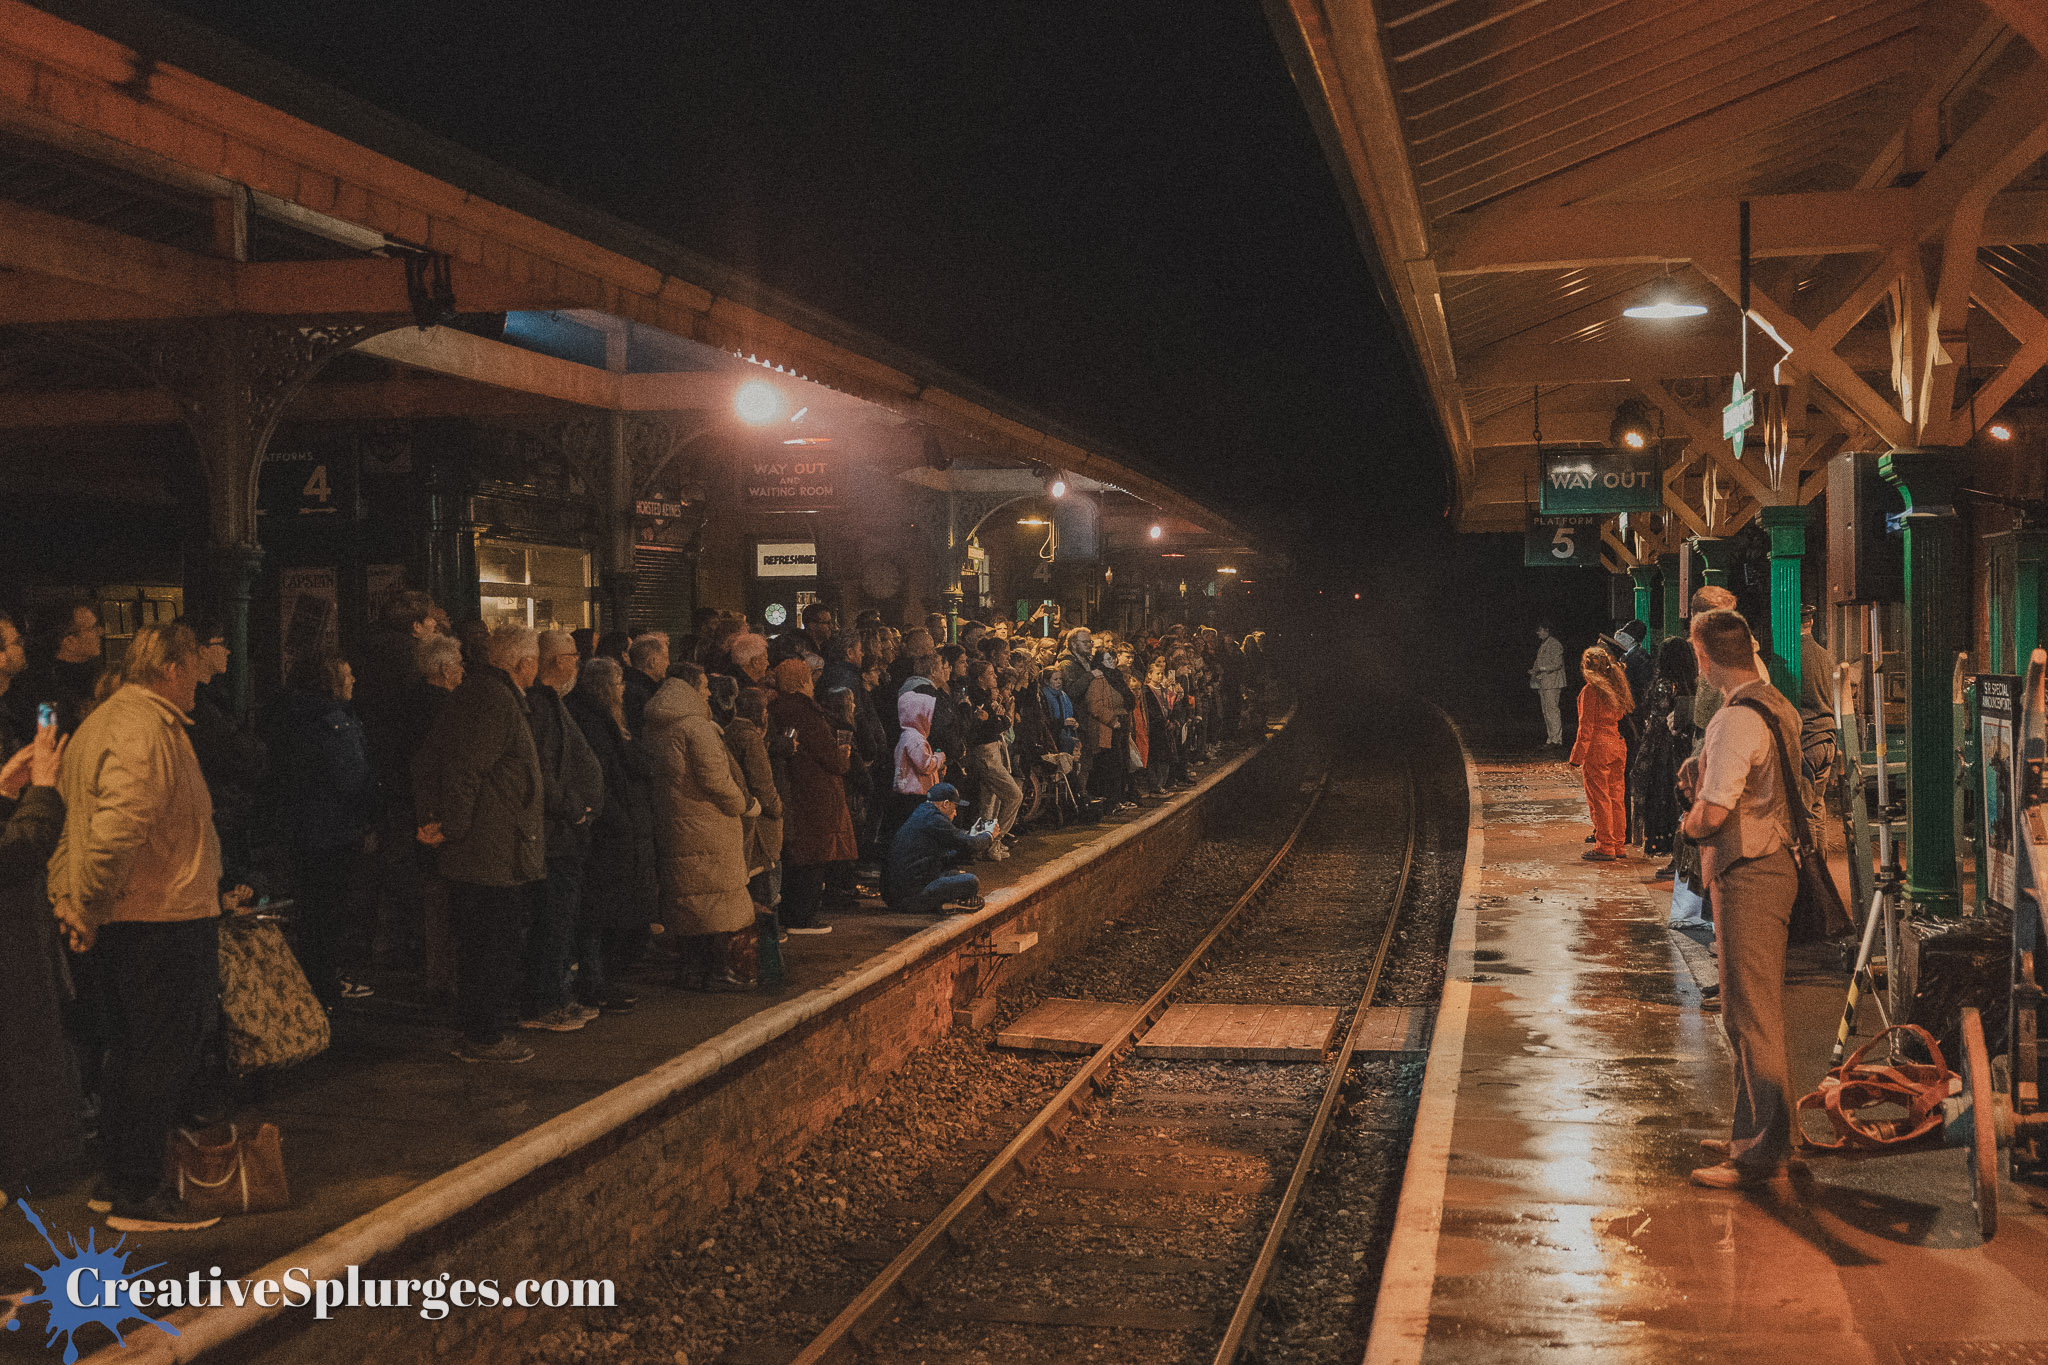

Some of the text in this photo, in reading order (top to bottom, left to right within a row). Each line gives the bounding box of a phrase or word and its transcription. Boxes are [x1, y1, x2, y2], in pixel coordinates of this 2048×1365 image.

[264, 451, 314, 462] ATFORMS
[754, 462, 828, 475] WAY OUT
[303, 464, 332, 502] 4
[780, 477, 800, 485] AND
[1550, 471, 1649, 489] WAY OUT
[749, 485, 833, 497] WAITING ROOM
[1533, 516, 1593, 525] PLATFORM
[1551, 528, 1575, 559] 5
[764, 555, 816, 565] REFRESHME
[1033, 560, 1051, 584] 4
